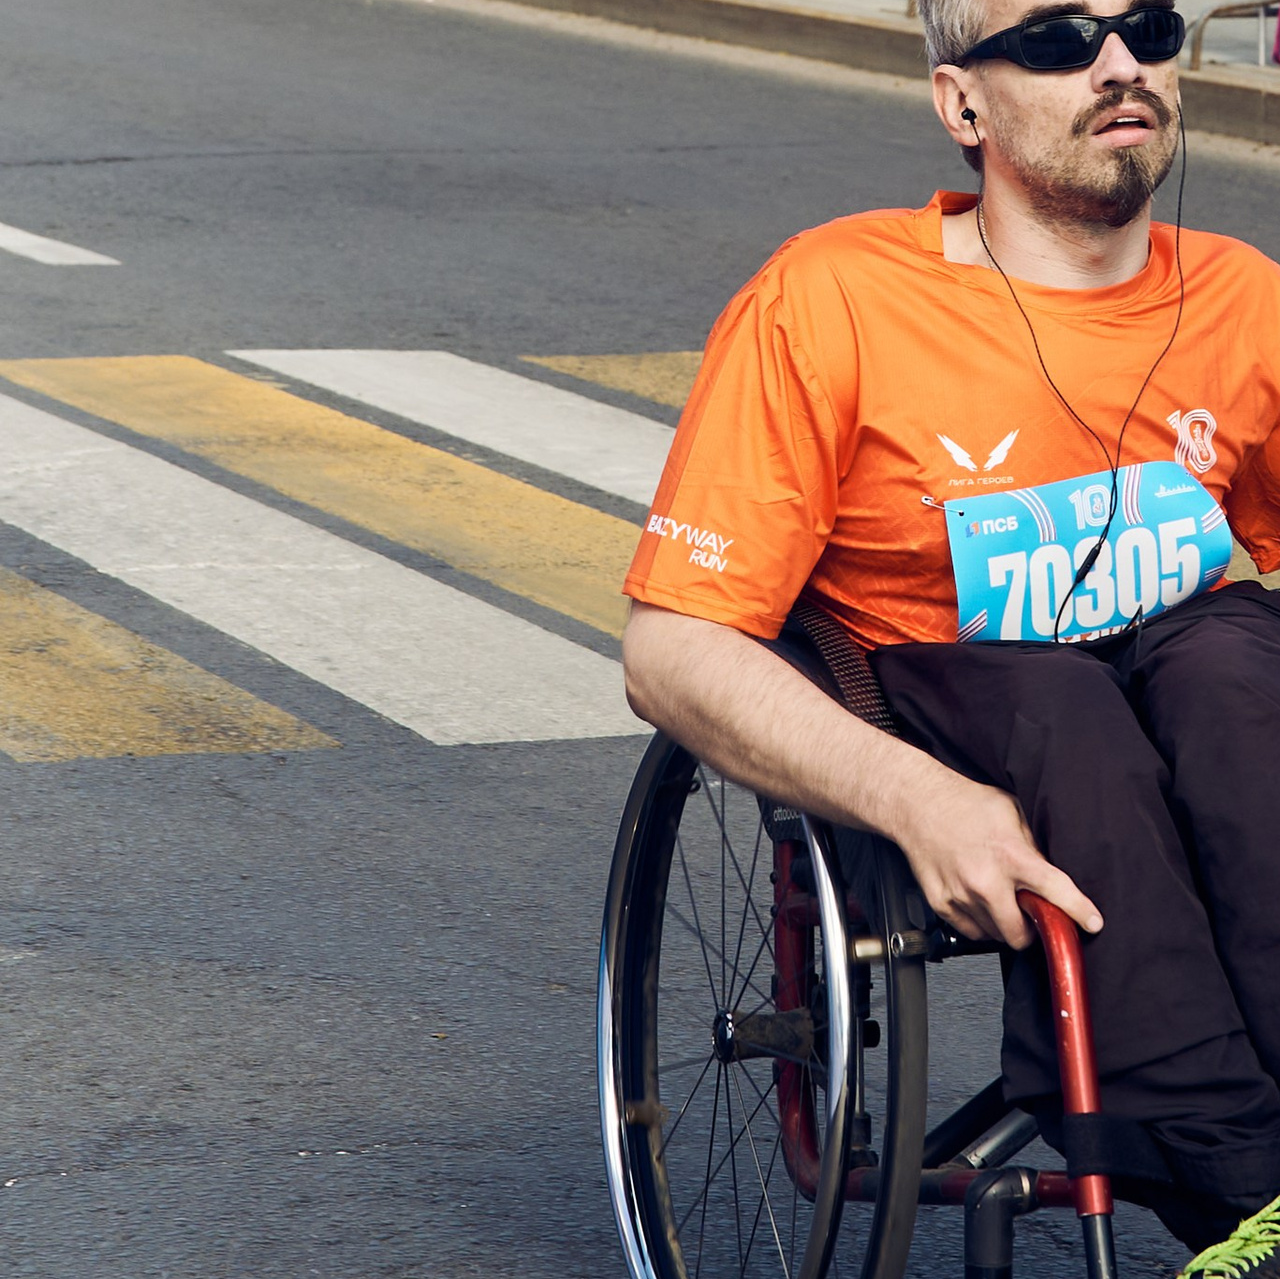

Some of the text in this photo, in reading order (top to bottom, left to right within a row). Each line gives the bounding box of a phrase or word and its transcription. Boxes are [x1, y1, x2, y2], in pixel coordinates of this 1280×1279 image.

[948, 475, 1015, 487] ЛИГА ГЕРОЕВ
[1068, 484, 1111, 531] 10
[982, 515, 1019, 536] ПСБ
[688, 548, 728, 573] RUN
[987, 516, 1201, 642] 70305
